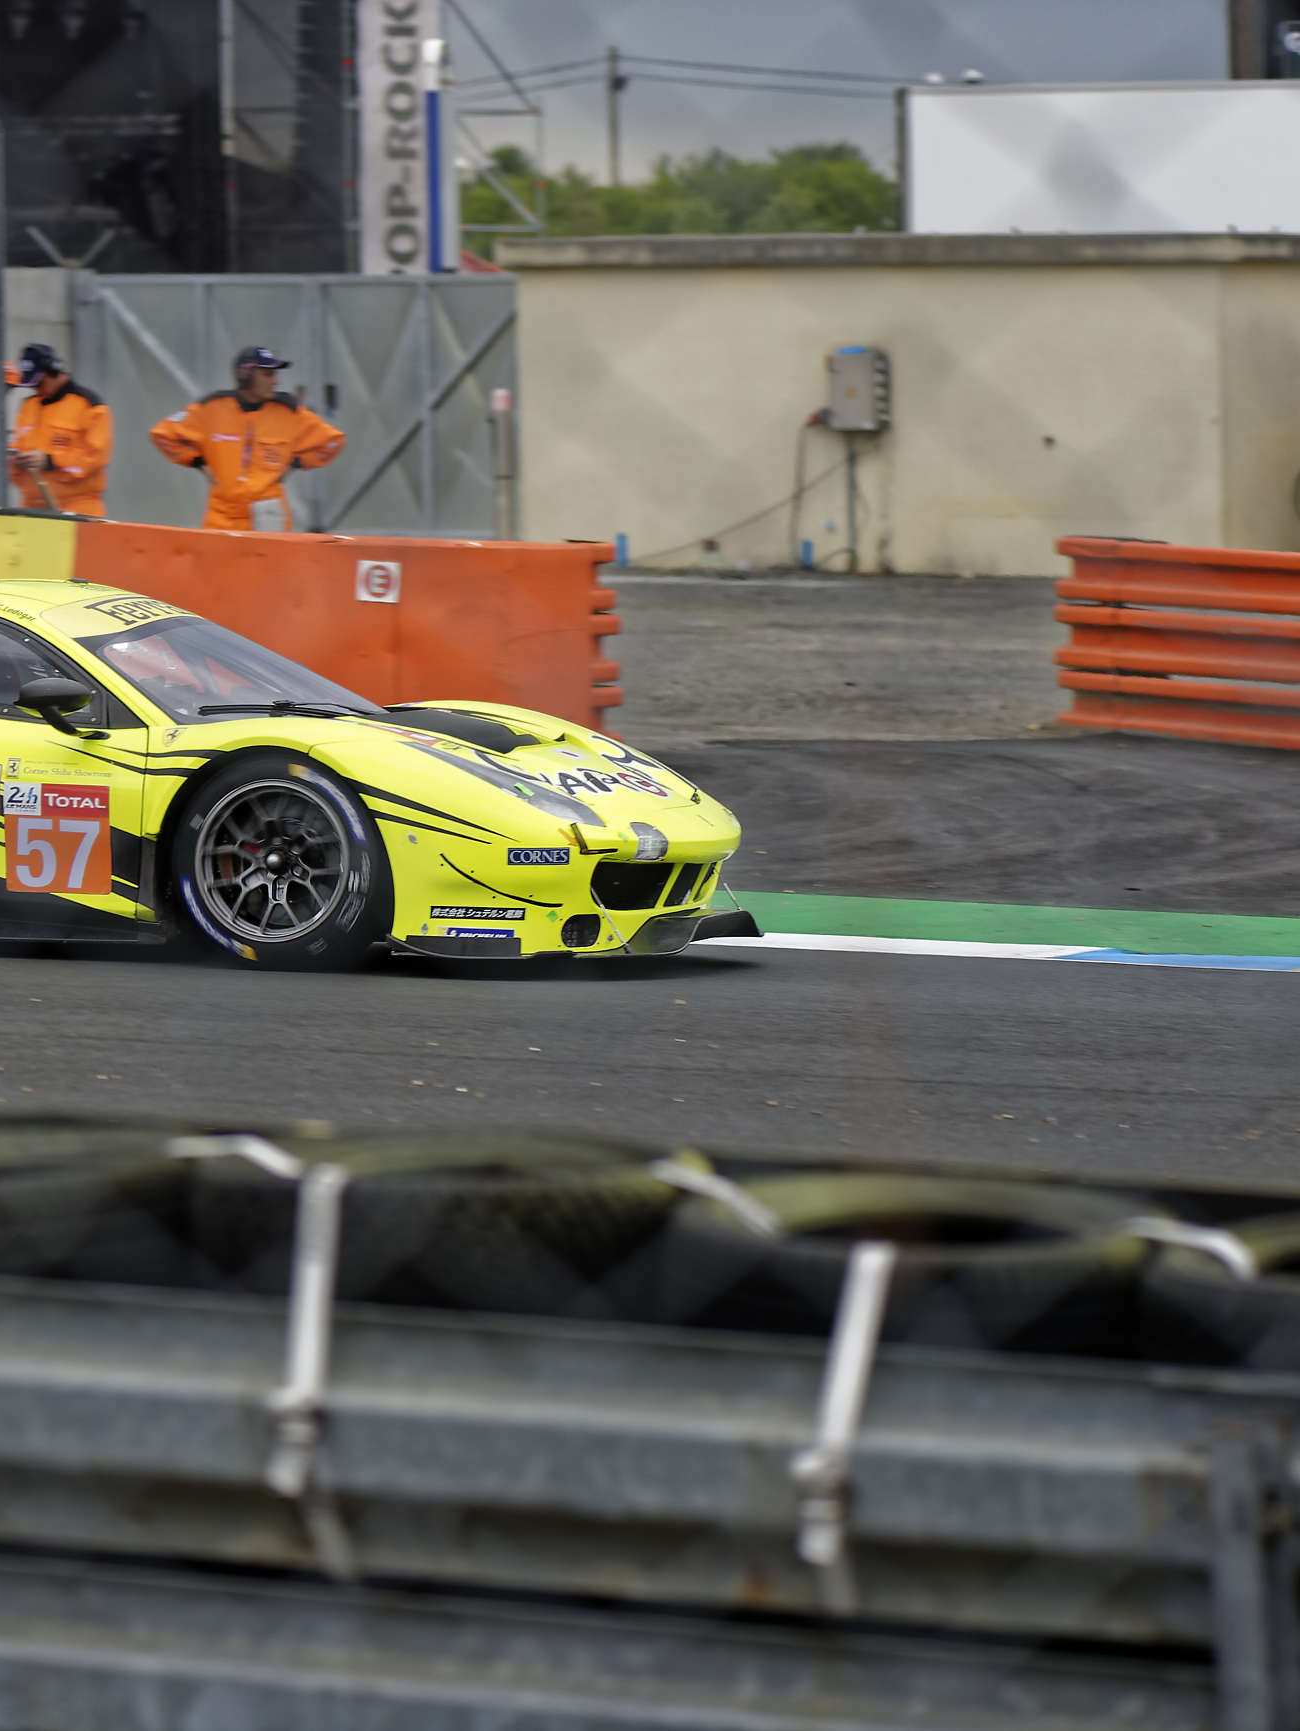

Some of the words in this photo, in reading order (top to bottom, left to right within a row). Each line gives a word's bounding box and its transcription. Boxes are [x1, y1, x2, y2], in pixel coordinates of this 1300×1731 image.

[382, 0, 419, 275] OP-ROCK
[15, 817, 100, 889] 57
[509, 849, 569, 863] CORNES
